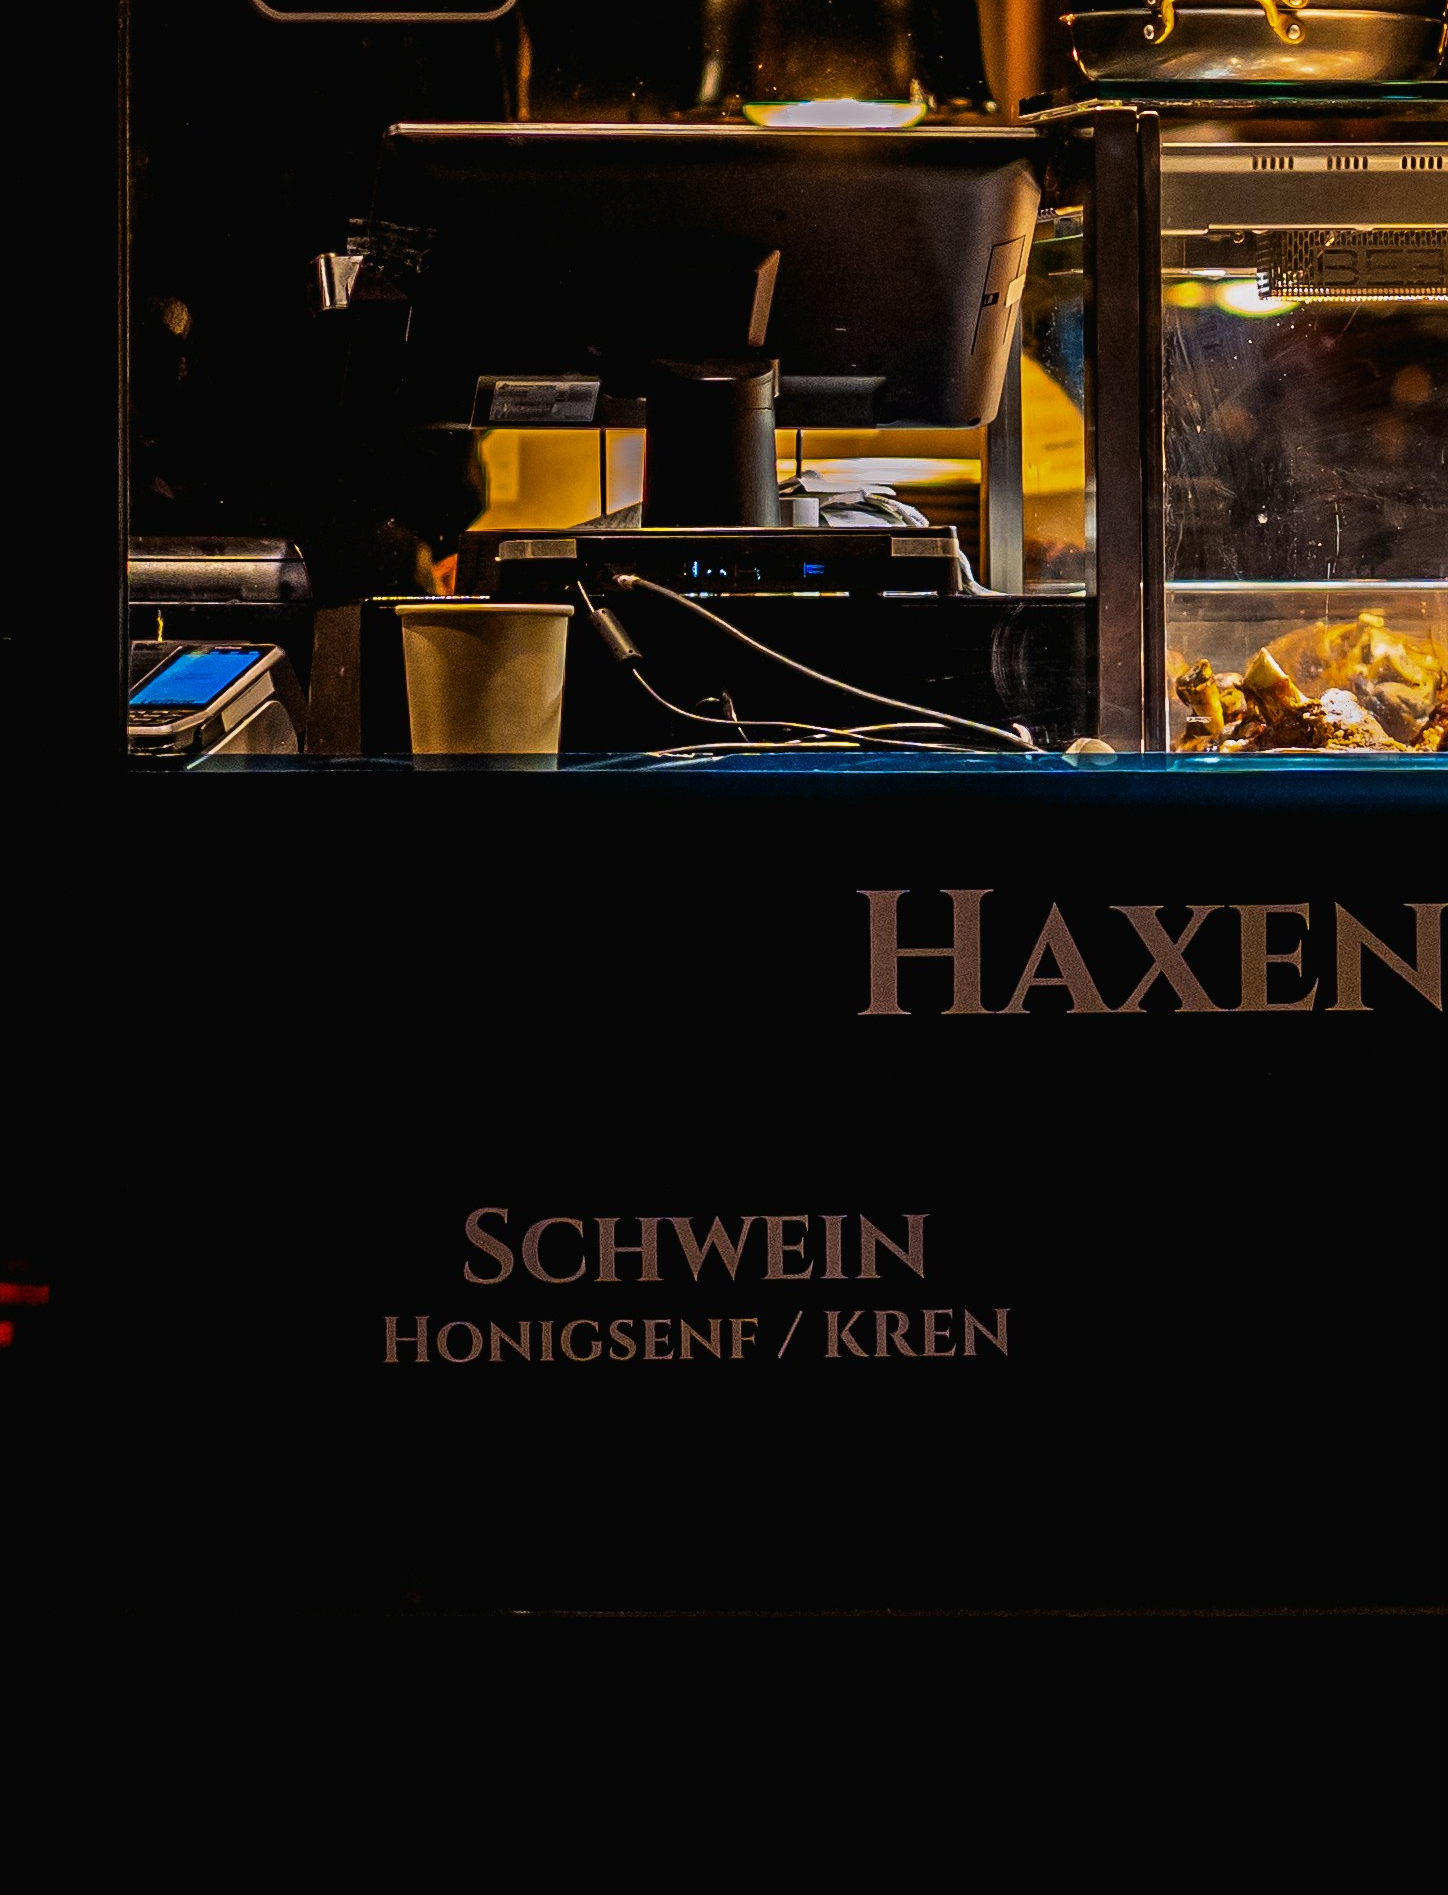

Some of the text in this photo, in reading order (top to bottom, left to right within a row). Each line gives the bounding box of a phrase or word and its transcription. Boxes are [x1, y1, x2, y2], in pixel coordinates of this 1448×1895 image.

[462, 1205, 930, 1287] SCHWEIN
[383, 1314, 760, 1365] HONIGSENF
[824, 1306, 1011, 1360] KREN
